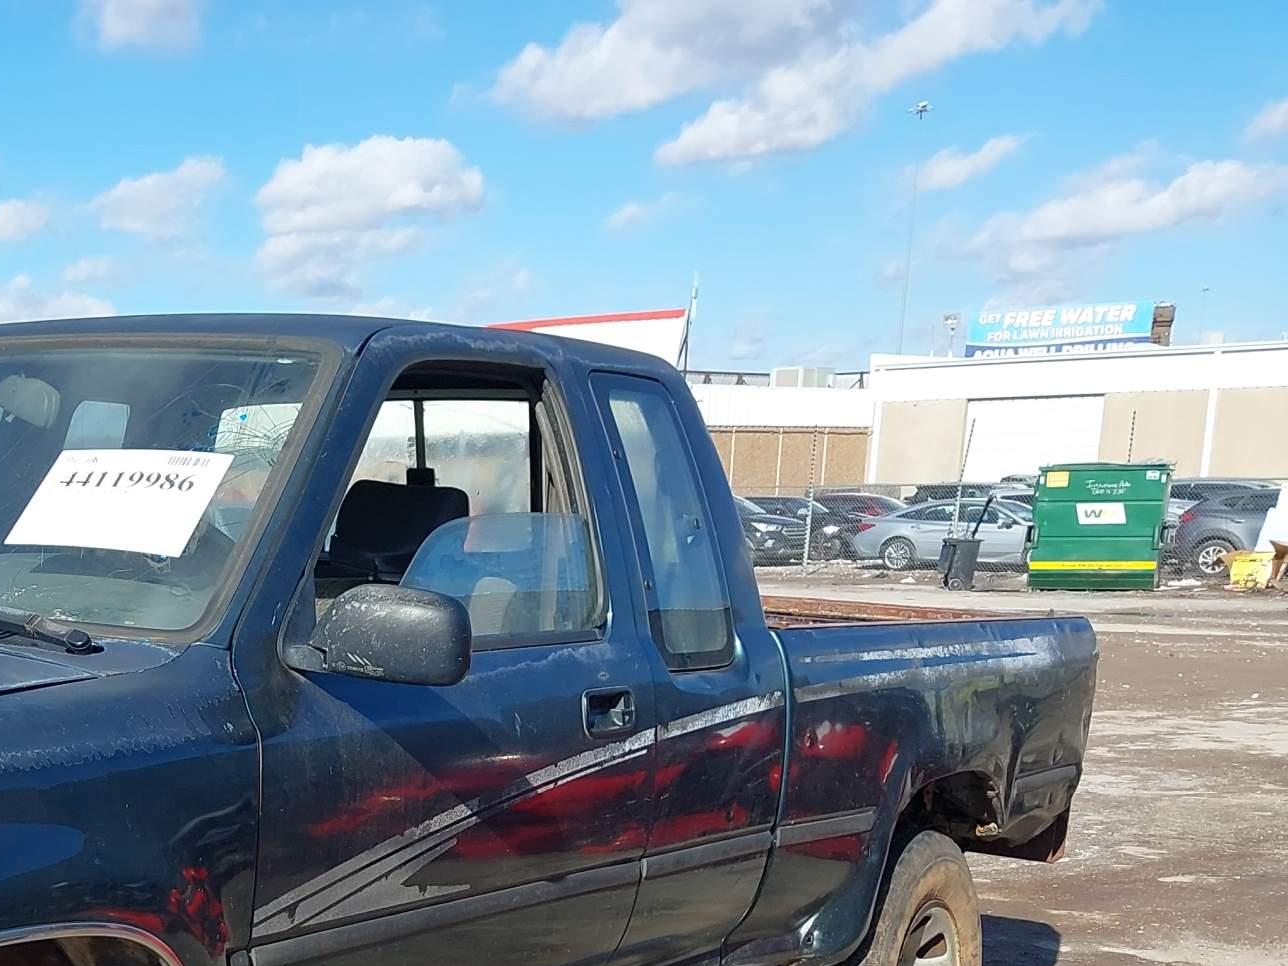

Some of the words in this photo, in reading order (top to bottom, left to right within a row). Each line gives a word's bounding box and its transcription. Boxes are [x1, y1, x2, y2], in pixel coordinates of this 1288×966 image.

[979, 313, 1002, 325] GET
[1003, 310, 1056, 328] FREE
[1062, 305, 1137, 323] WATER
[986, 331, 1010, 342] FOR
[1013, 328, 1048, 340] LAWN
[1051, 324, 1123, 338] IRRIGATION
[59, 471, 196, 491] 44119986
